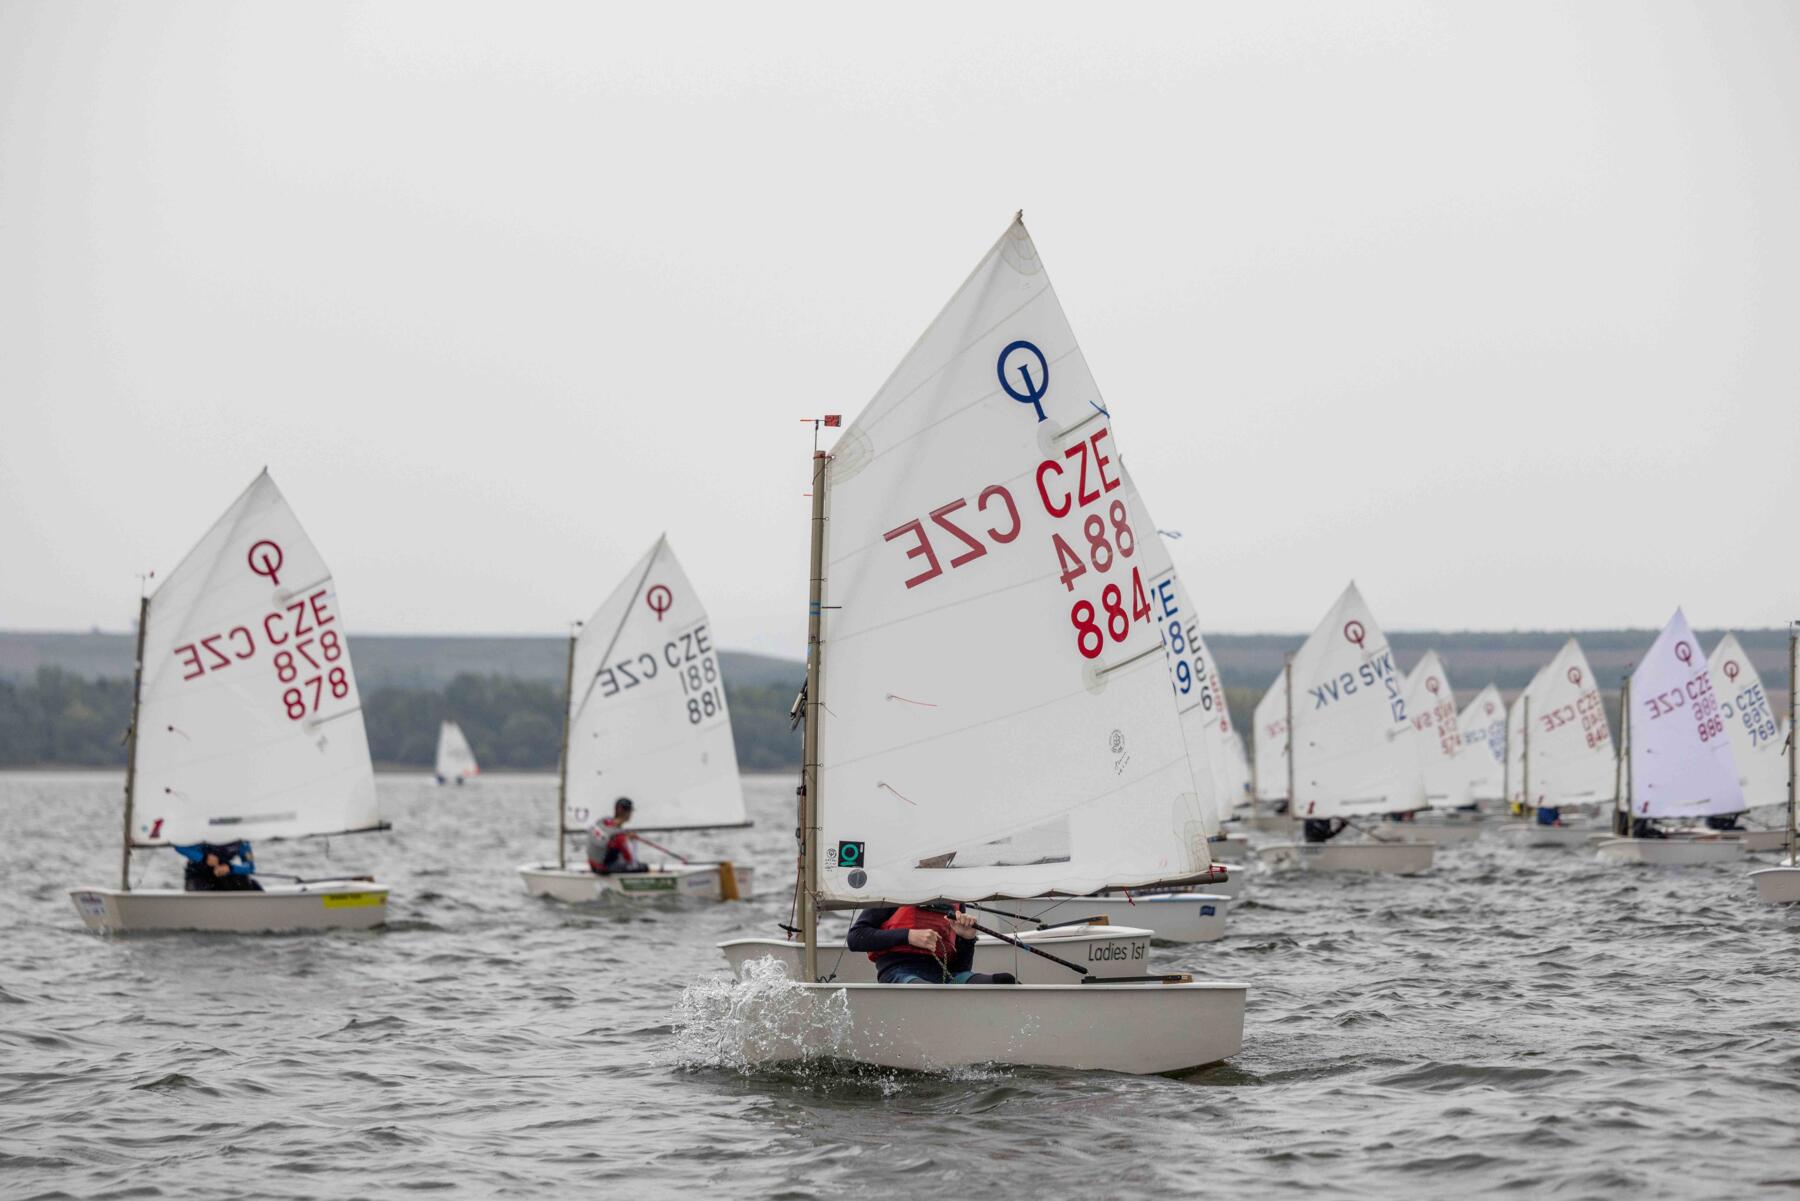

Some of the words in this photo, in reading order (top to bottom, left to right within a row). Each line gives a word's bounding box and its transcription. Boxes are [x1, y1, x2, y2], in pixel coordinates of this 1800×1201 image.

[1036, 427, 1121, 518] CZE
[264, 589, 335, 645] CZE
[1071, 566, 1151, 659] 884
[664, 625, 711, 668] CZE
[1359, 652, 1393, 687] SVK
[1686, 671, 1712, 700] CZE
[283, 667, 349, 720] 878
[687, 686, 722, 724] 881
[1391, 698, 1407, 723] 12
[1736, 684, 1763, 711] CZE
[1697, 714, 1723, 742] 886
[1748, 720, 1775, 747] 769
[1088, 941, 1127, 961] Ladies
[1131, 941, 1145, 960] 1st
